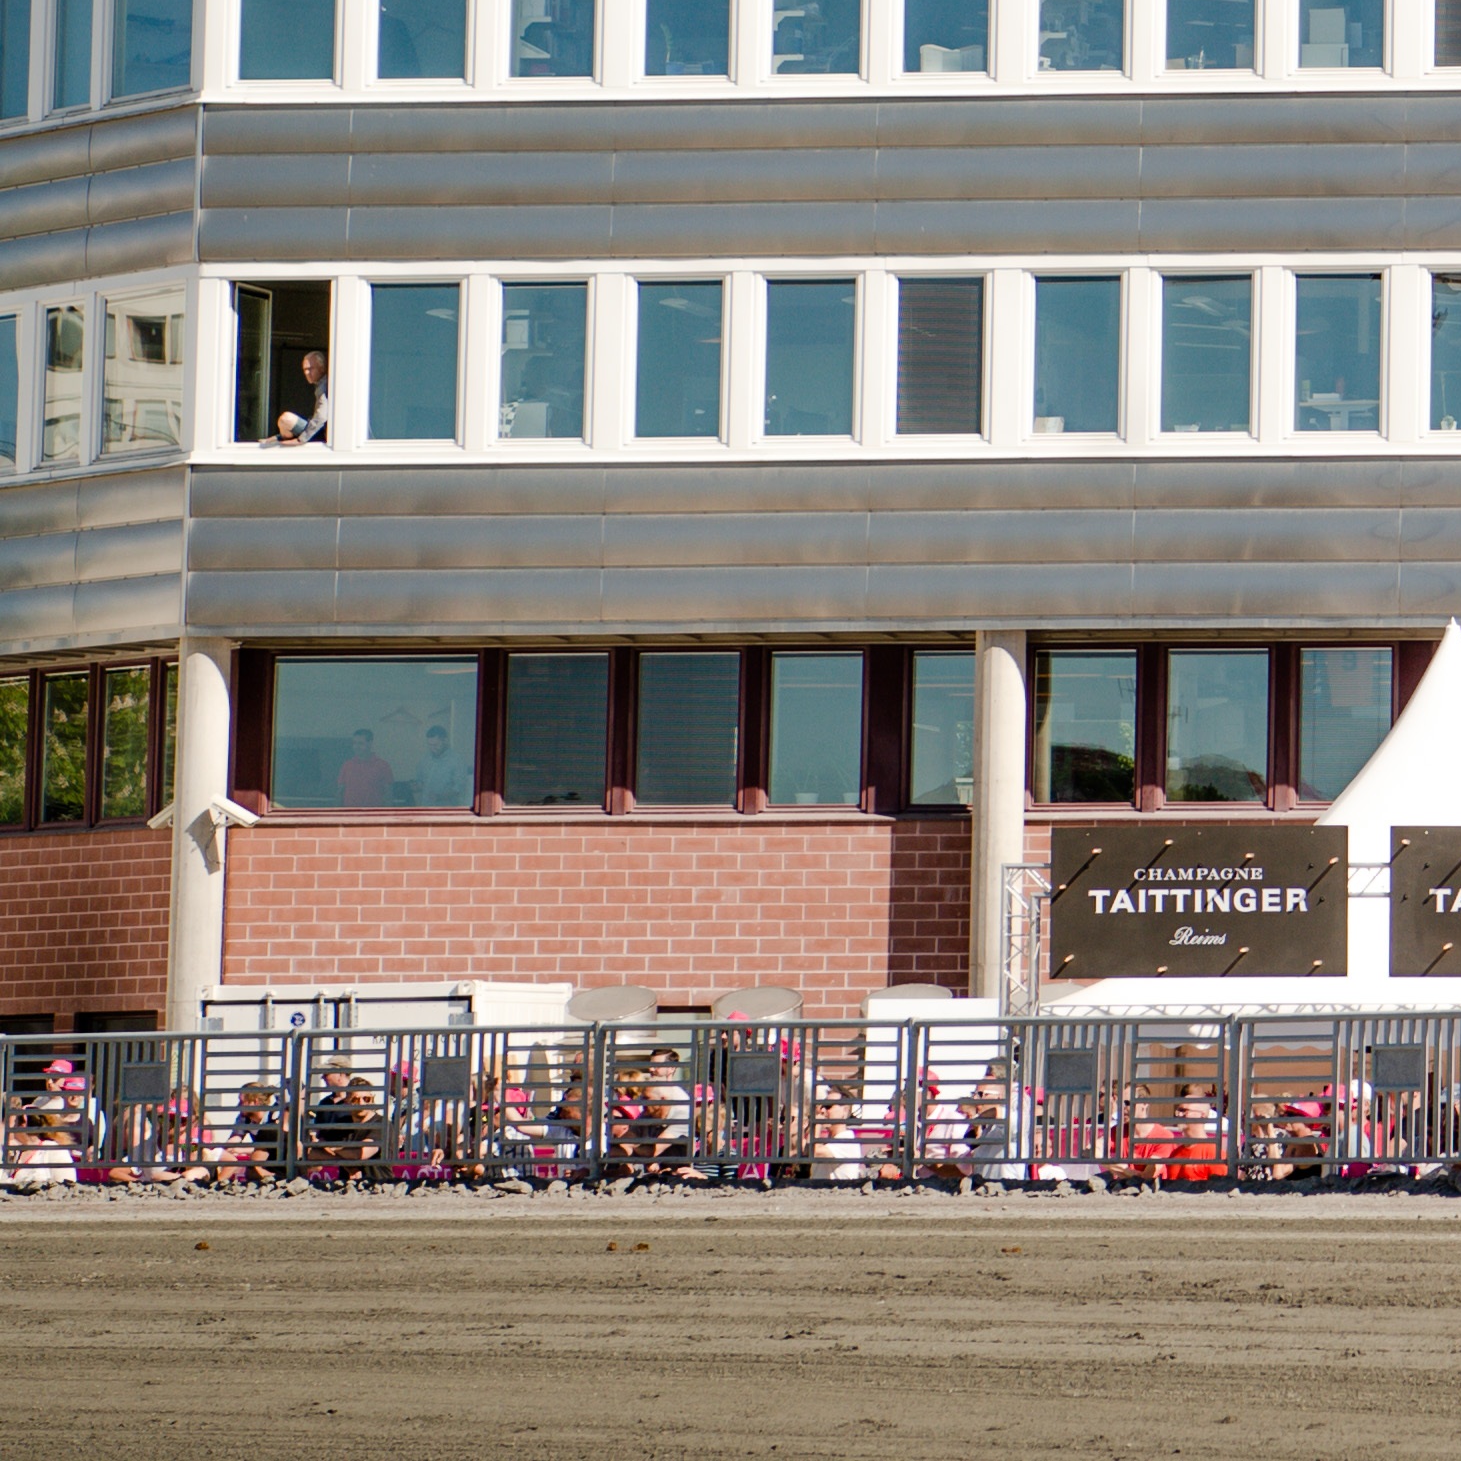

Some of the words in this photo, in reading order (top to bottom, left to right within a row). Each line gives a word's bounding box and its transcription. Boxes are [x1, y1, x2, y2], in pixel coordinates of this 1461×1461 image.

[1133, 867, 1263, 881] CHAMPAGNE
[1088, 887, 1308, 914] TAITTINGER
[1169, 926, 1227, 946] Reims
